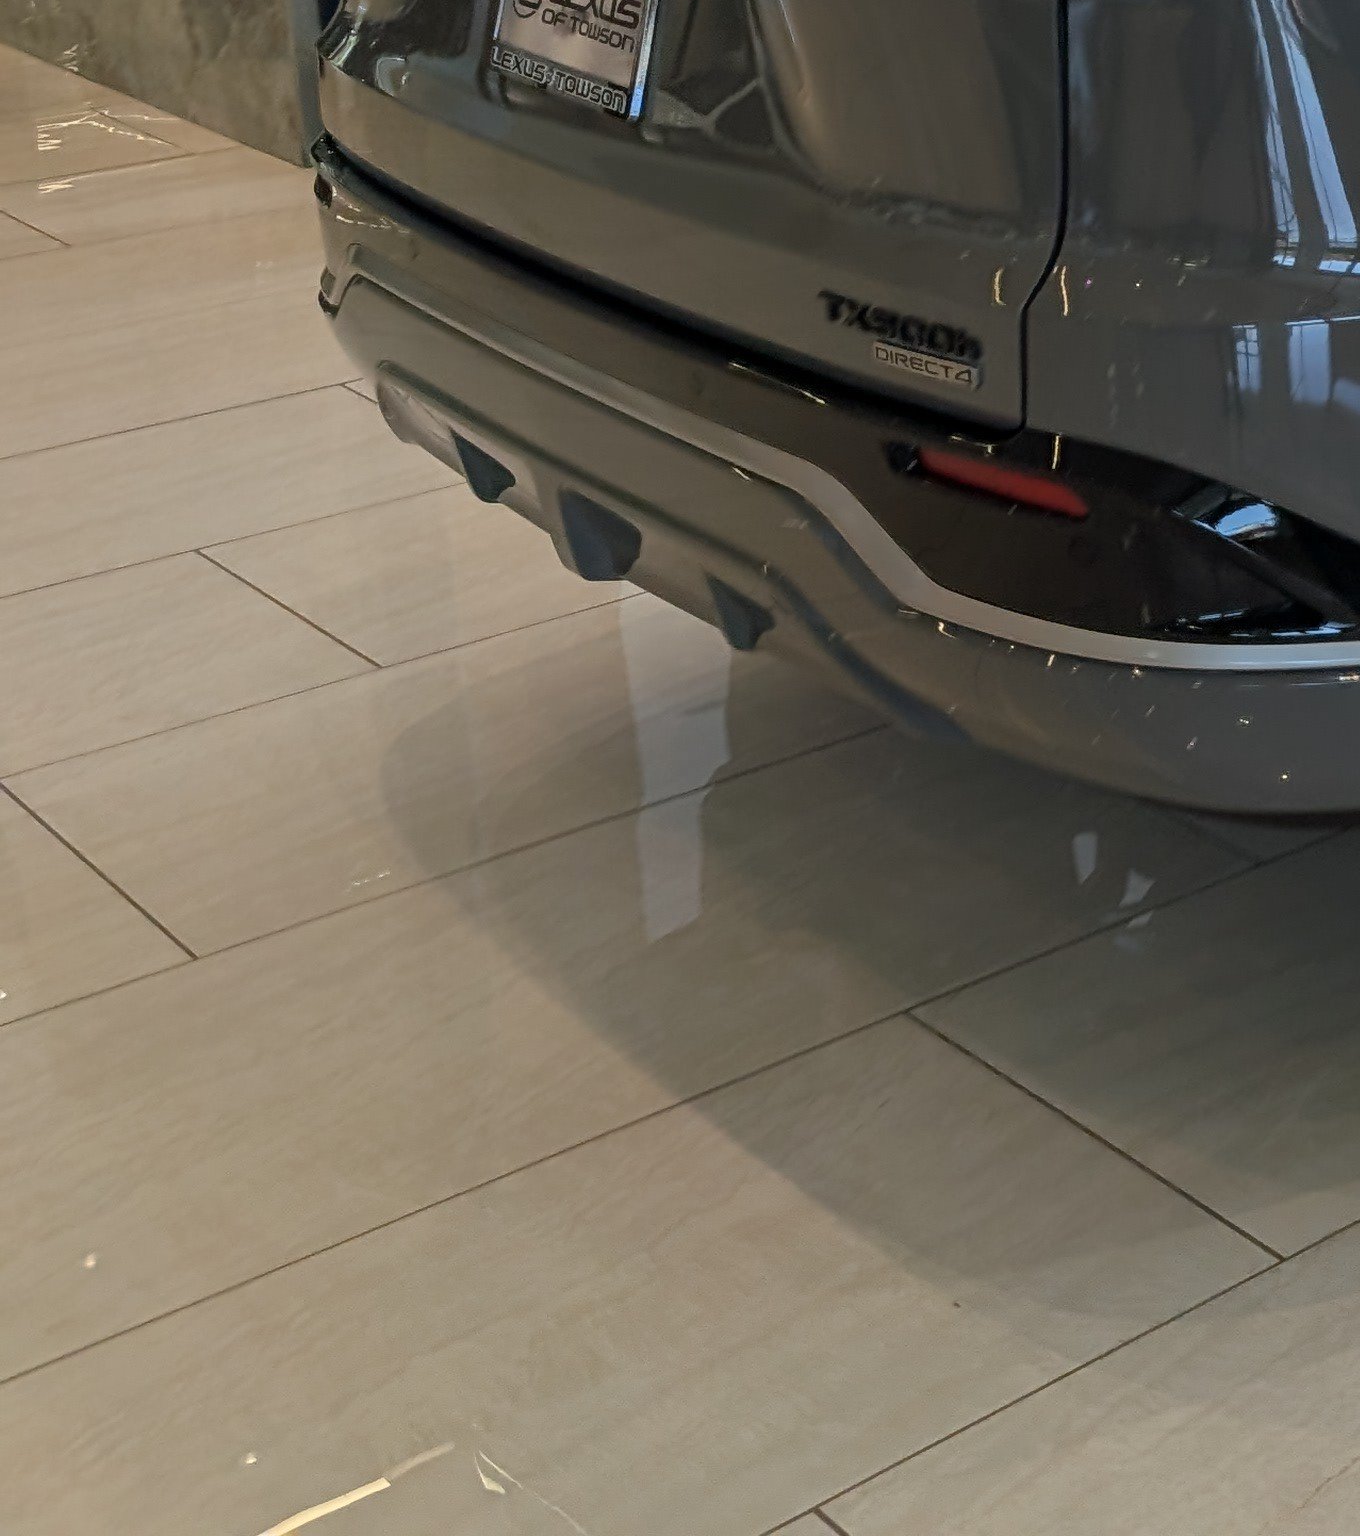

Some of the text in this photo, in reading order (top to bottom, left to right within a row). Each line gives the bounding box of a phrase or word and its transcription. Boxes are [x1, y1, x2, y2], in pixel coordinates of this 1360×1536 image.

[541, 7, 635, 53] OF TOWSON
[490, 46, 626, 113] LEXUS TOWSON
[875, 346, 973, 385] DIRECT4
